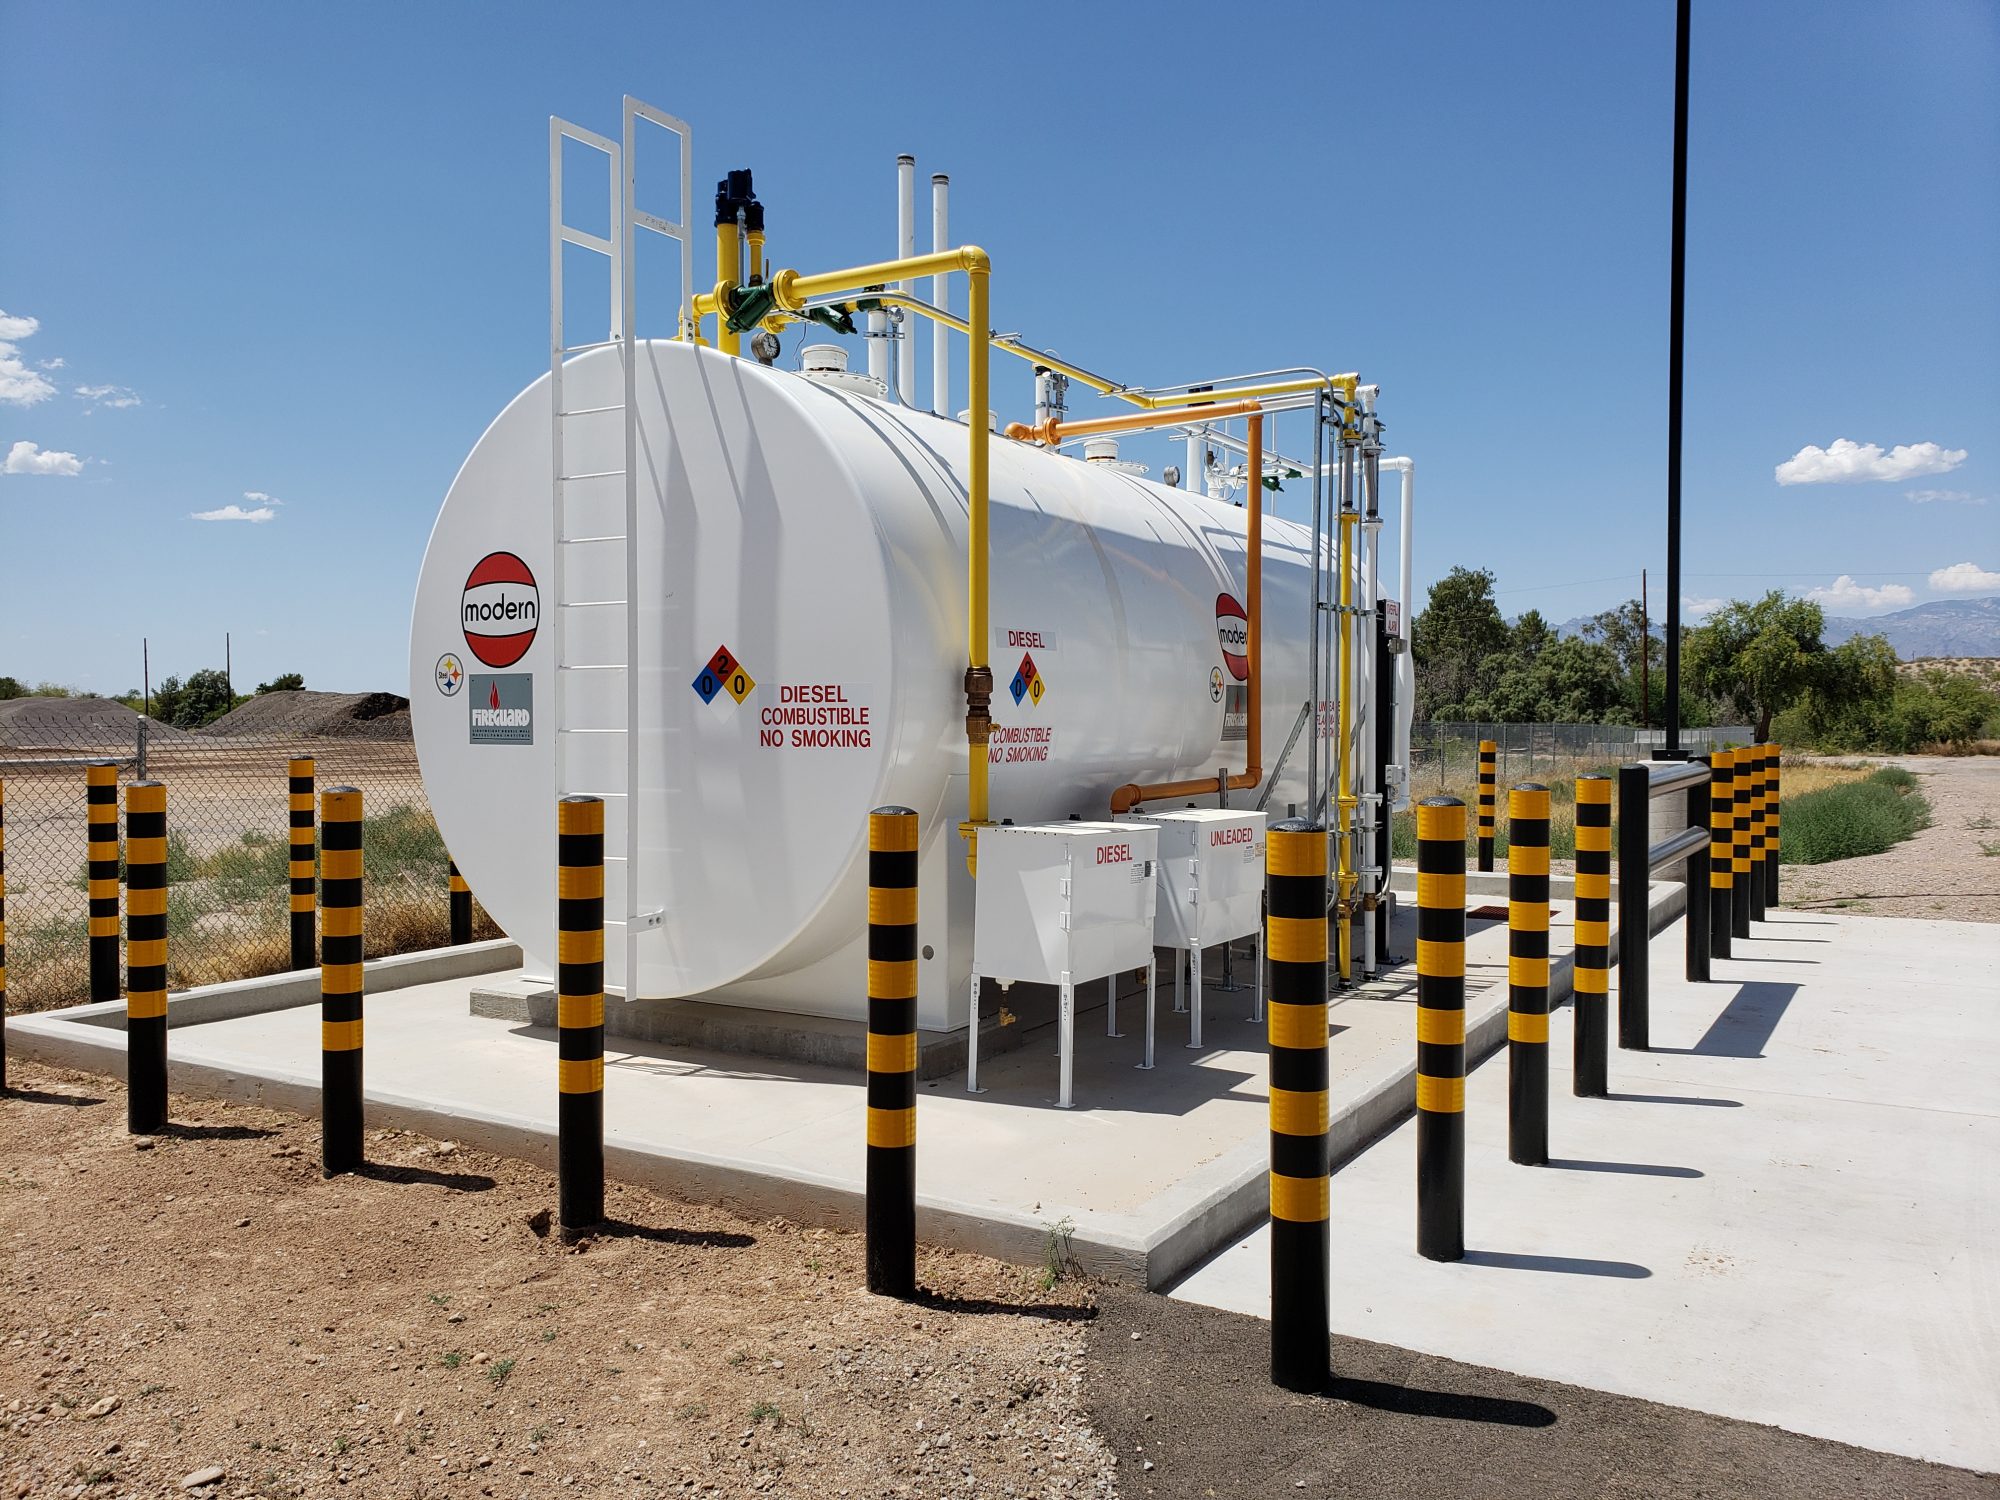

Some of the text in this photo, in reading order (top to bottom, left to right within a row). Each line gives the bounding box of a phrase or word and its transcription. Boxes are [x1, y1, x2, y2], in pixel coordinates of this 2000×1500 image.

[465, 593, 535, 622] modern
[1008, 630, 1045, 648] DIESEL
[717, 655, 729, 674] 2
[1024, 661, 1031, 678] 2
[702, 675, 745, 695] 0 0
[781, 685, 848, 703] DIESEL
[1015, 679, 1040, 698] 0 0
[761, 707, 869, 725] COMBUSTIBLE
[760, 729, 871, 748] NO SMOKING
[993, 728, 1051, 744] COMBUSTIBLE
[988, 746, 1048, 763] NO SMOKING
[1210, 827, 1253, 847] UNLEADED
[1096, 843, 1133, 864] DIESEL
